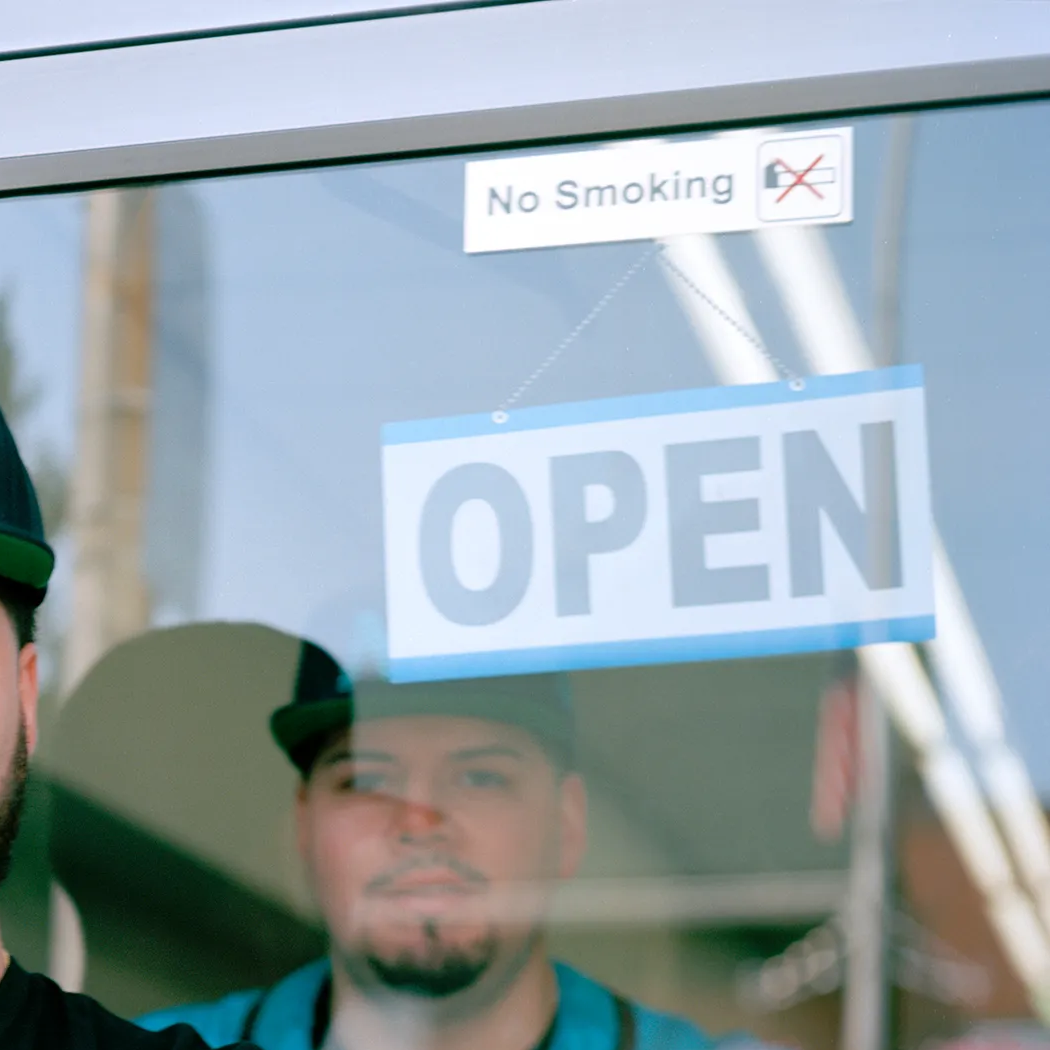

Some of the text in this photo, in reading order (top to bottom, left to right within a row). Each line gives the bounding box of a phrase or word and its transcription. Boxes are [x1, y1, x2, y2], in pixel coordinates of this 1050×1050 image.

[487, 170, 734, 216] No Smoking
[419, 421, 903, 627] OPEN
